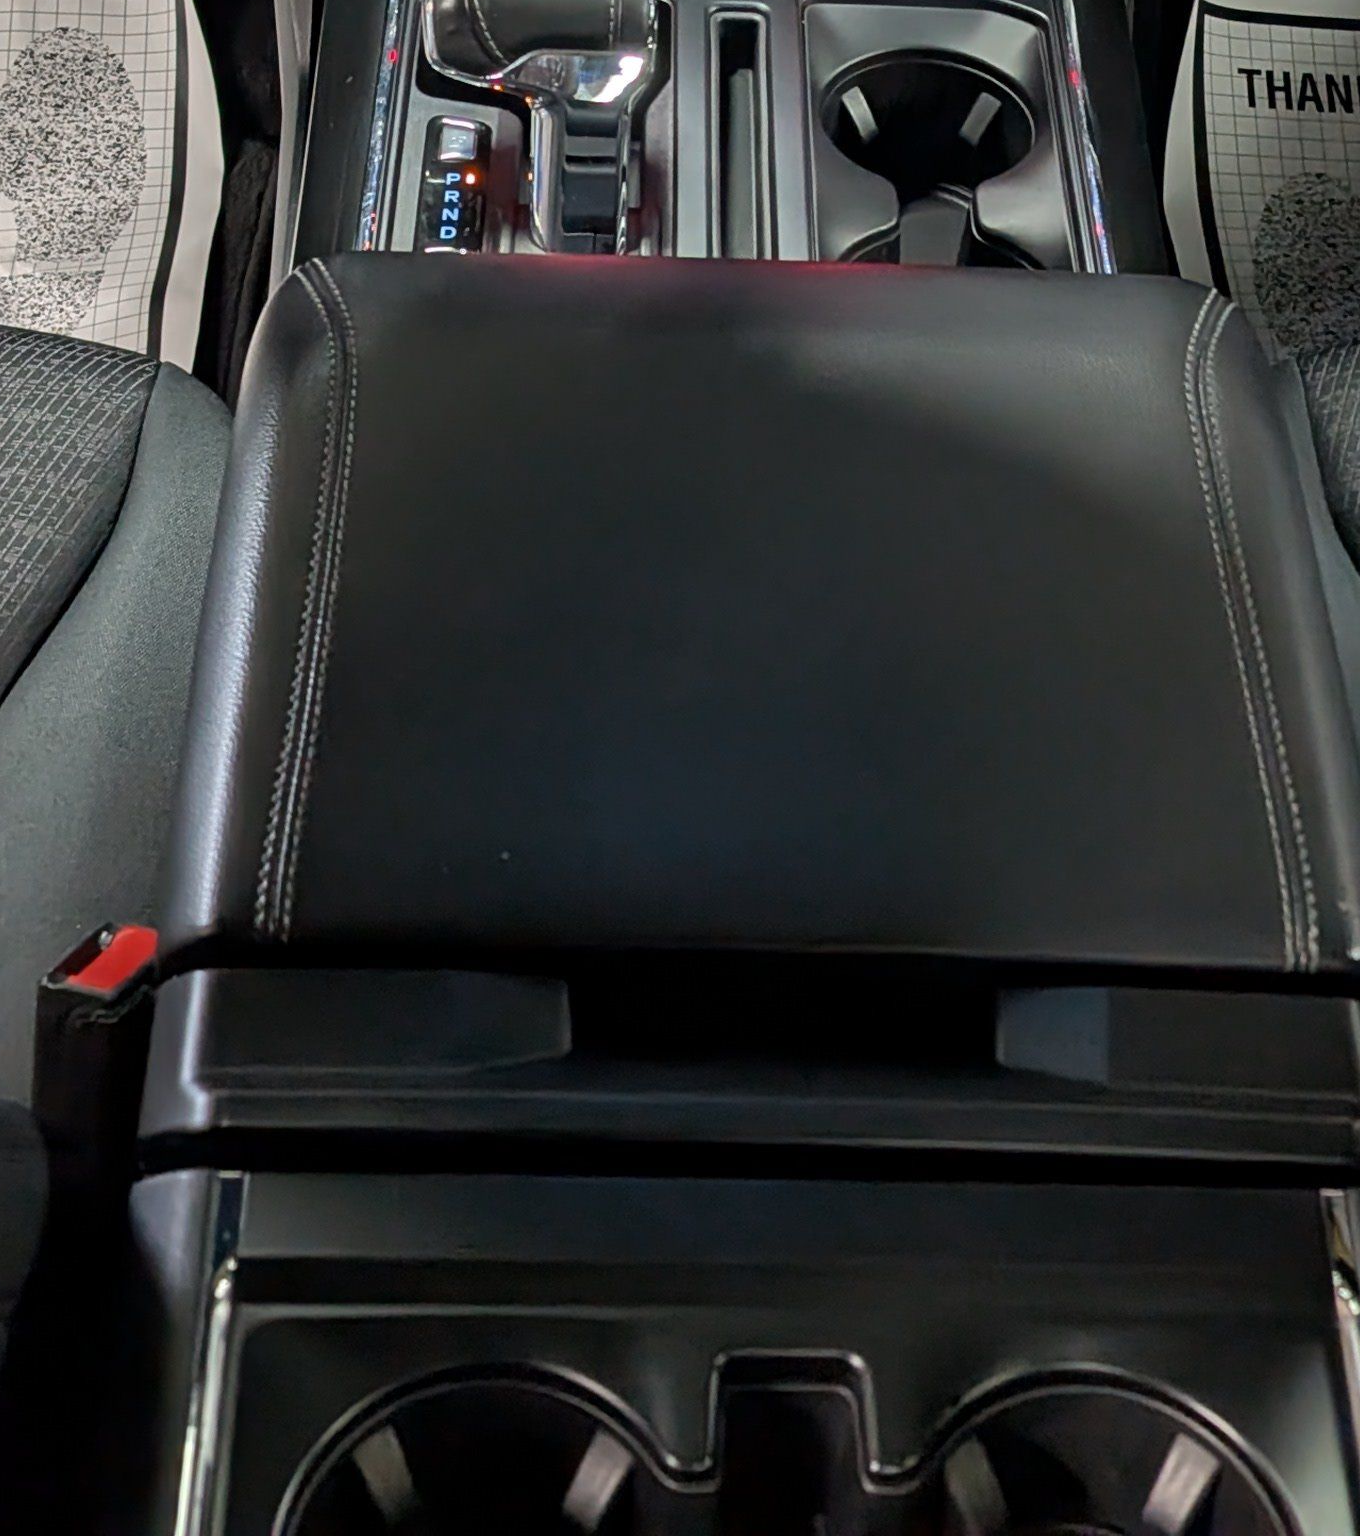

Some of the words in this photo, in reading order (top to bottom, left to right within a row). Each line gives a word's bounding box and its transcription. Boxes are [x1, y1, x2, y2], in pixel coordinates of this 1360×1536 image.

[445, 172, 460, 185] P
[444, 190, 459, 203] R
[441, 208, 459, 221] N
[439, 226, 457, 239] D
